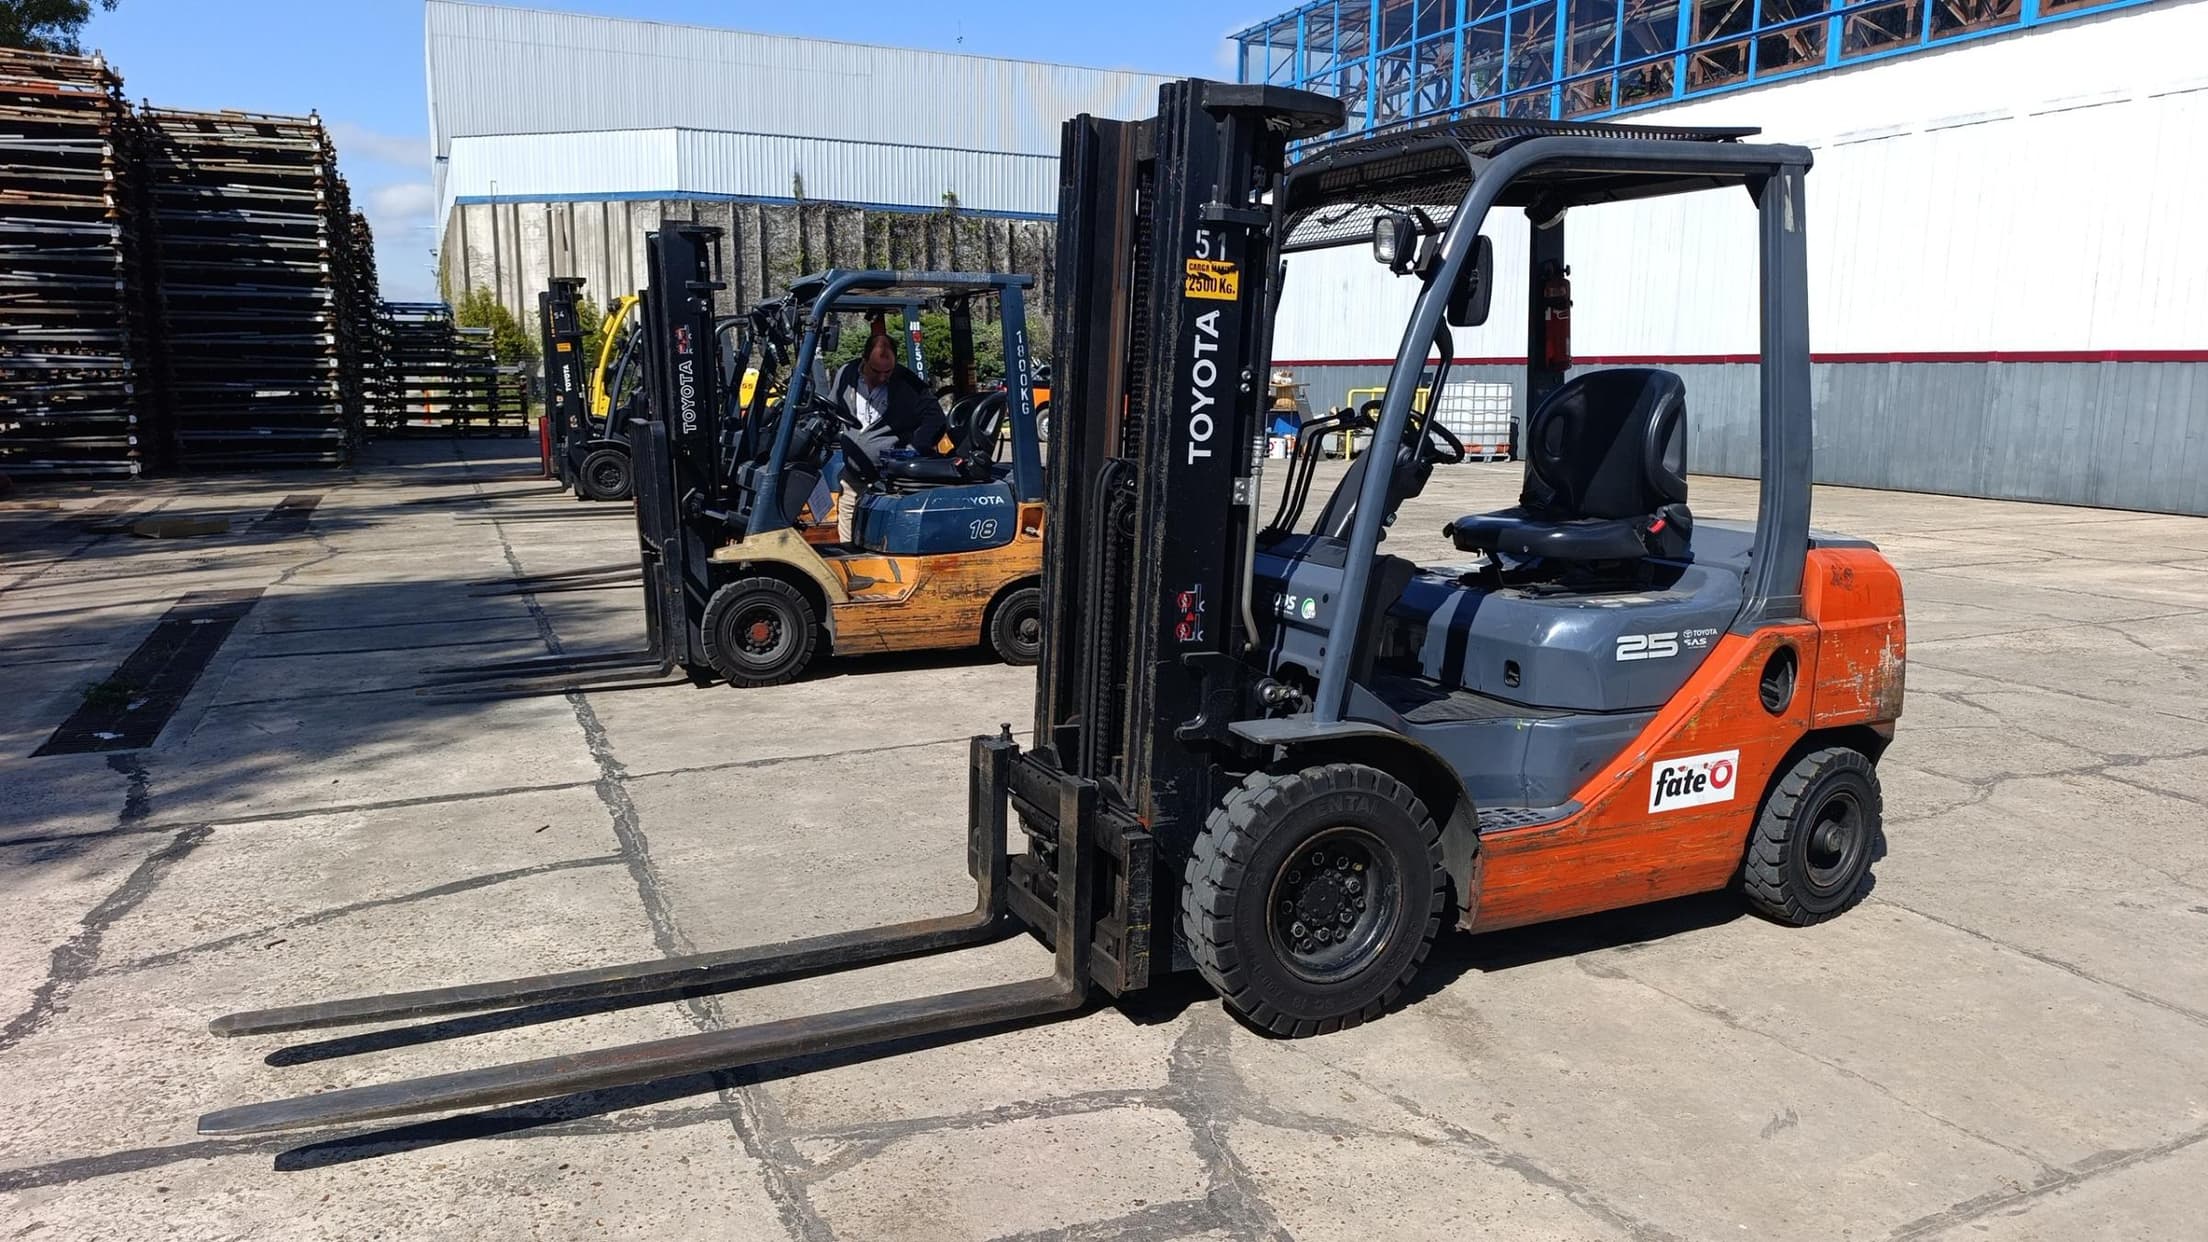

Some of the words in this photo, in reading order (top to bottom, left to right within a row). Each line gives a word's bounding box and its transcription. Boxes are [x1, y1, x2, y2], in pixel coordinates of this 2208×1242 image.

[1195, 229, 1227, 261] 51
[1189, 276, 1217, 293] 2500
[563, 364, 572, 392] TOYOTA
[1188, 309, 1221, 465] TOYOTA
[679, 360, 697, 434] TOYOTA
[966, 495, 1005, 506] YOTA
[969, 519, 998, 539] 18
[1616, 631, 1679, 661] 25
[1693, 628, 1718, 637] TOYOTA
[1653, 767, 1707, 807] fate
